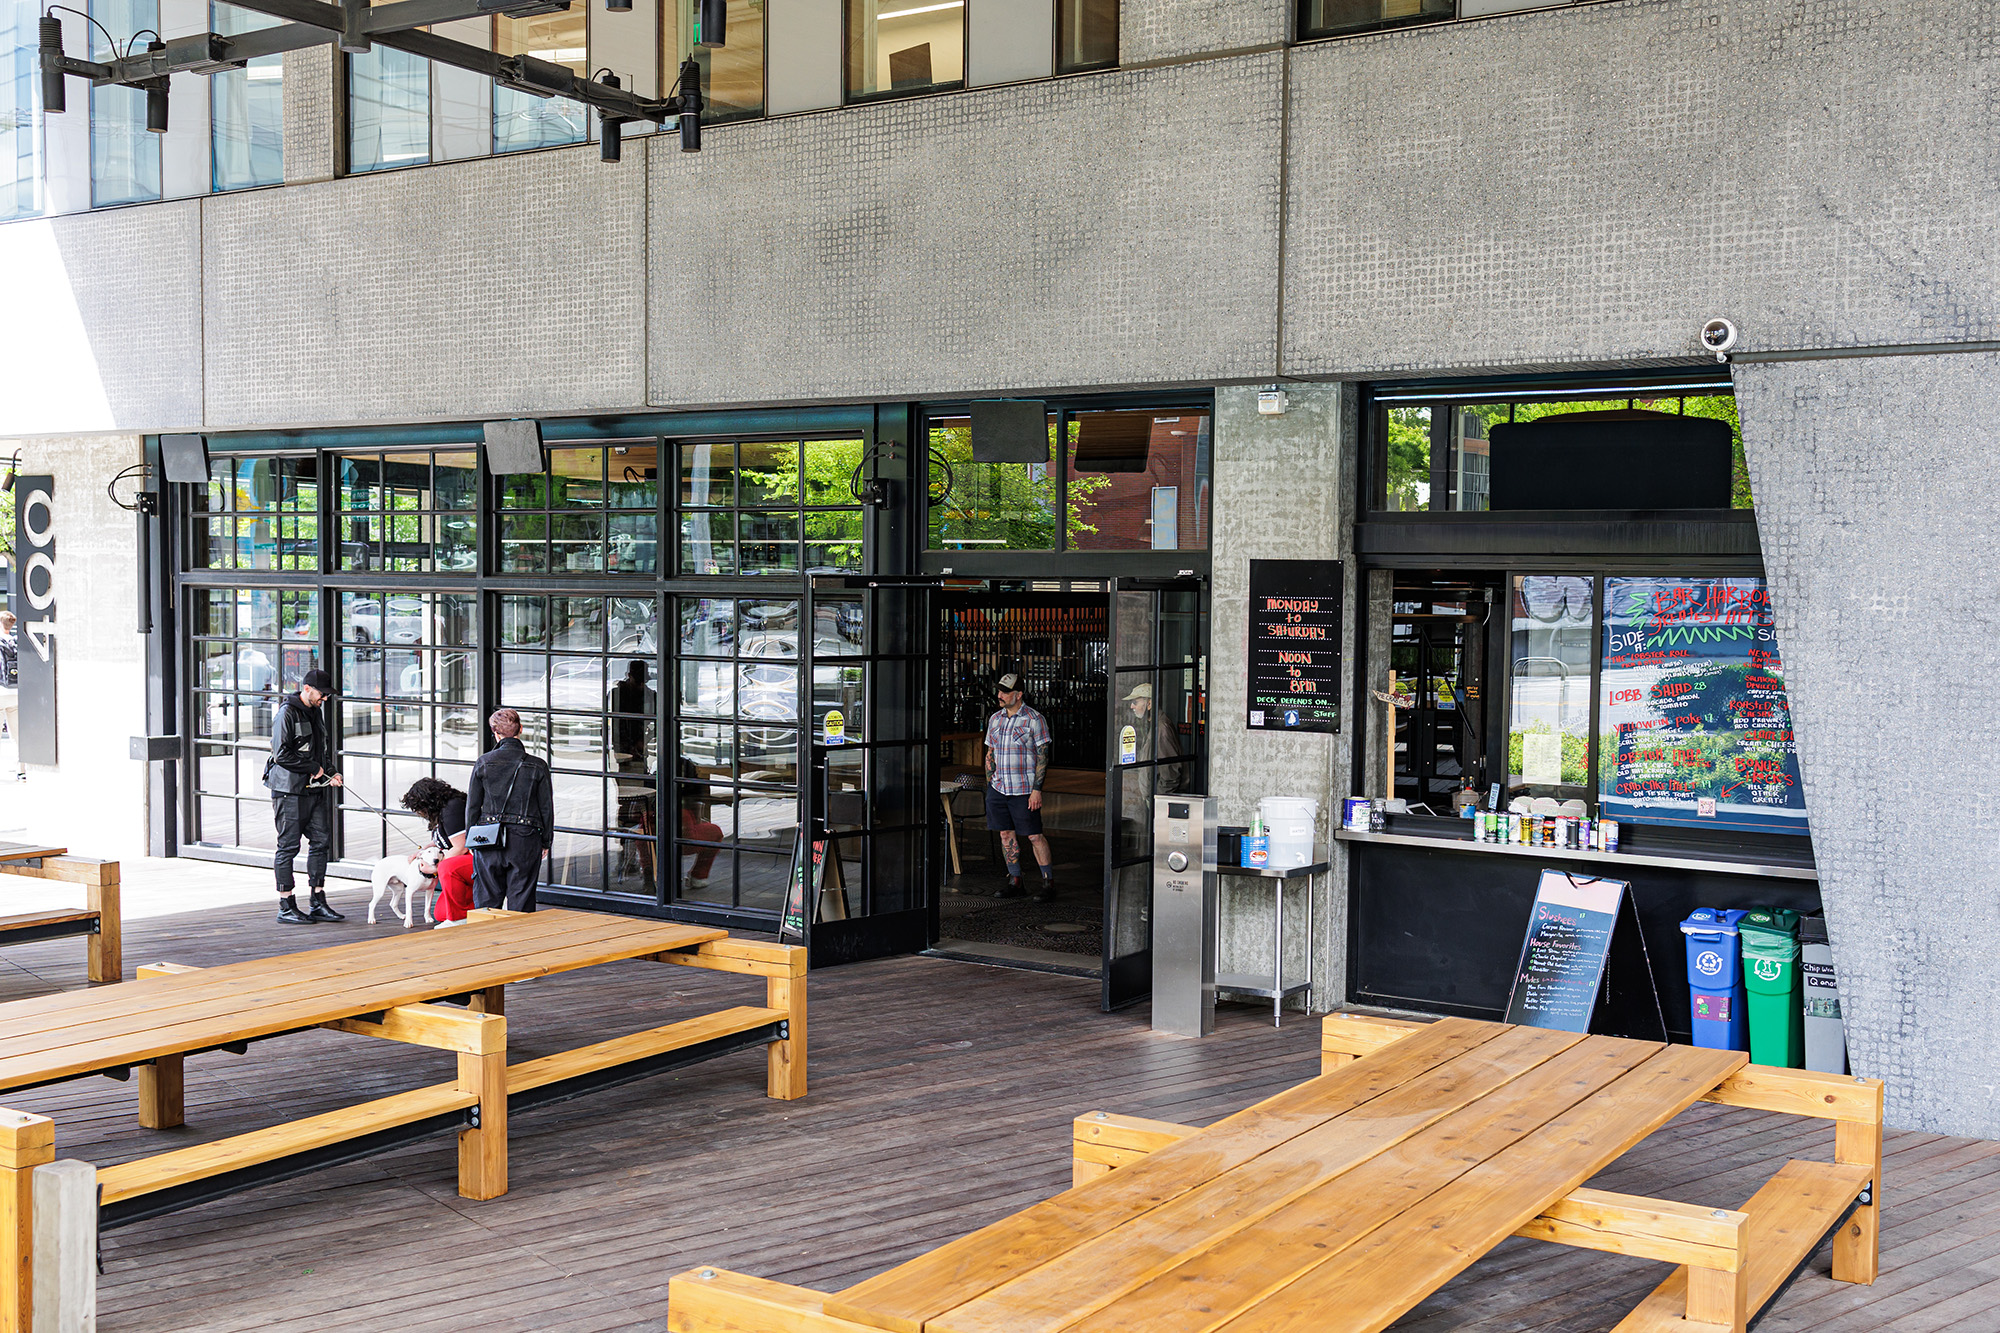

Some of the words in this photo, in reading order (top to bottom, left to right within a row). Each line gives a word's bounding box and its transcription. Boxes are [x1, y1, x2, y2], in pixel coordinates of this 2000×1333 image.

[23, 489, 56, 663] 400
[1267, 599, 1318, 612] MONDAY
[1652, 587, 1702, 616] BAR
[1285, 613, 1301, 623] to
[1648, 608, 1719, 635] GREATEST
[1725, 610, 1774, 626] HITS
[1267, 625, 1325, 639] SATURDAY
[1758, 629, 1777, 641] SI
[1610, 630, 1645, 652] SIDE
[1278, 652, 1312, 664] NOON
[1630, 650, 1665, 660] LOBSTER
[1669, 649, 1691, 658] ROLL
[1747, 648, 1772, 658] NEW
[1286, 666, 1301, 677] to
[1290, 680, 1316, 692] 8PM
[1746, 682, 1778, 691] DEVILED
[1609, 689, 1643, 706] LOBB
[1650, 683, 1692, 698] SALAD
[1694, 682, 1707, 690] 28
[1256, 696, 1276, 704] DECK
[1280, 697, 1312, 705] DEPENDS
[1315, 698, 1335, 706] ON...
[1657, 701, 1688, 710] TOMATO
[1729, 700, 1772, 711] ROASTED
[1739, 710, 1775, 718] CAESAR
[1613, 716, 1670, 737] YELLOWFIN
[1675, 712, 1702, 727] POKE
[1743, 729, 1776, 741] CLAM
[1780, 730, 1794, 741] DI
[1611, 748, 1664, 766] LOBSTAH
[1672, 748, 1705, 762] MAC
[1734, 757, 1781, 772] BONUS
[1743, 771, 1794, 786] TRACKS
[1641, 780, 1667, 791] CAKE
[1668, 779, 1697, 792] MELT
[1645, 789, 1671, 797] TEXAS
[1538, 906, 1577, 926] Slushees
[1529, 937, 1551, 948] House
[1552, 940, 1582, 950] Favorites
[1803, 963, 1821, 973] Chip
[1520, 973, 1540, 984] Mules
